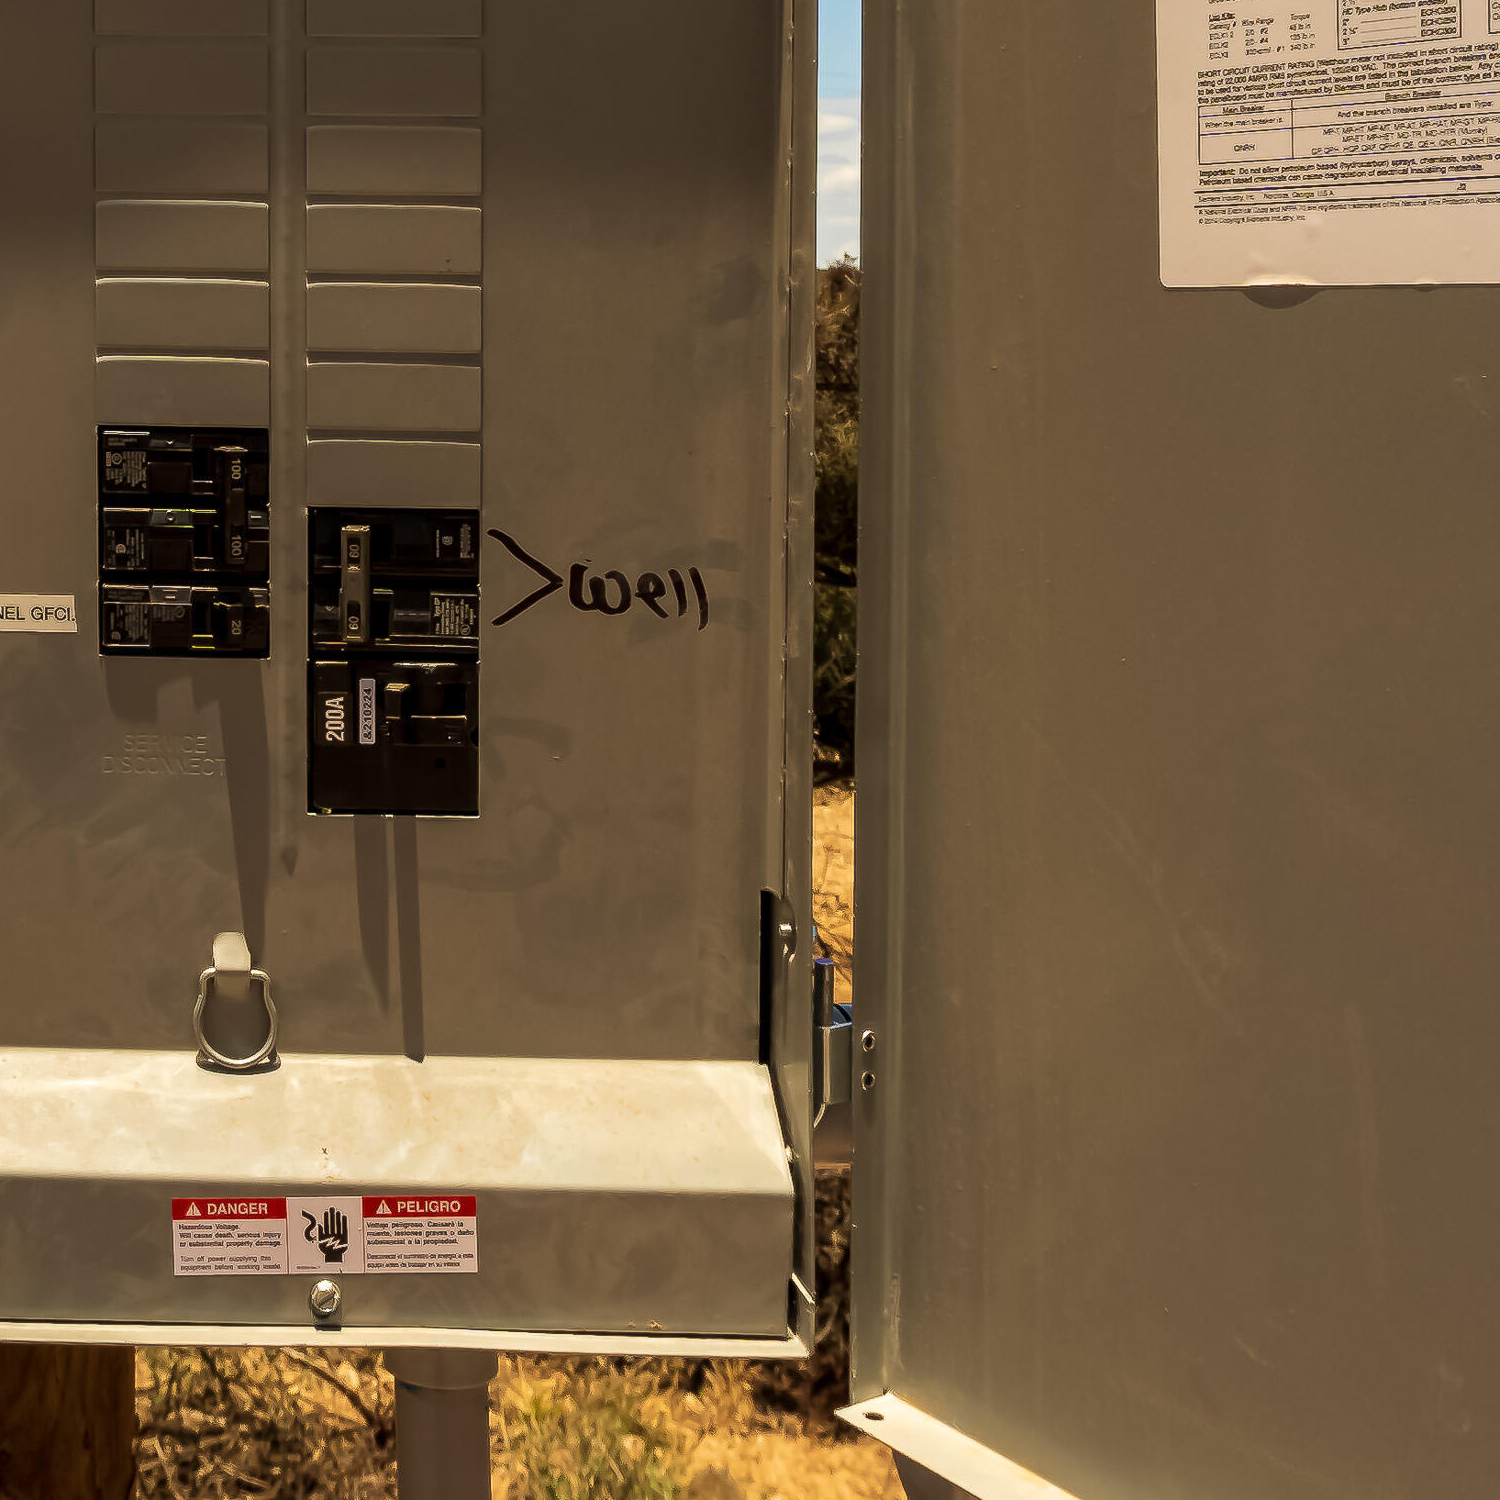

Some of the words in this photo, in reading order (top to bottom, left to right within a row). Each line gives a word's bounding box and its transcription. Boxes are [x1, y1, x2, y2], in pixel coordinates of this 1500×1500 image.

[231, 458, 241, 481] 100
[231, 534, 241, 557] 100
[349, 544, 360, 558] 60
[30, 606, 76, 621] GFCI.
[231, 619, 242, 635] 20
[349, 615, 360, 630] 60
[325, 696, 345, 742] 200A
[123, 734, 208, 754] SERVICE
[207, 1202, 268, 1215] DANGER
[397, 1200, 461, 1213] PELIGRO
